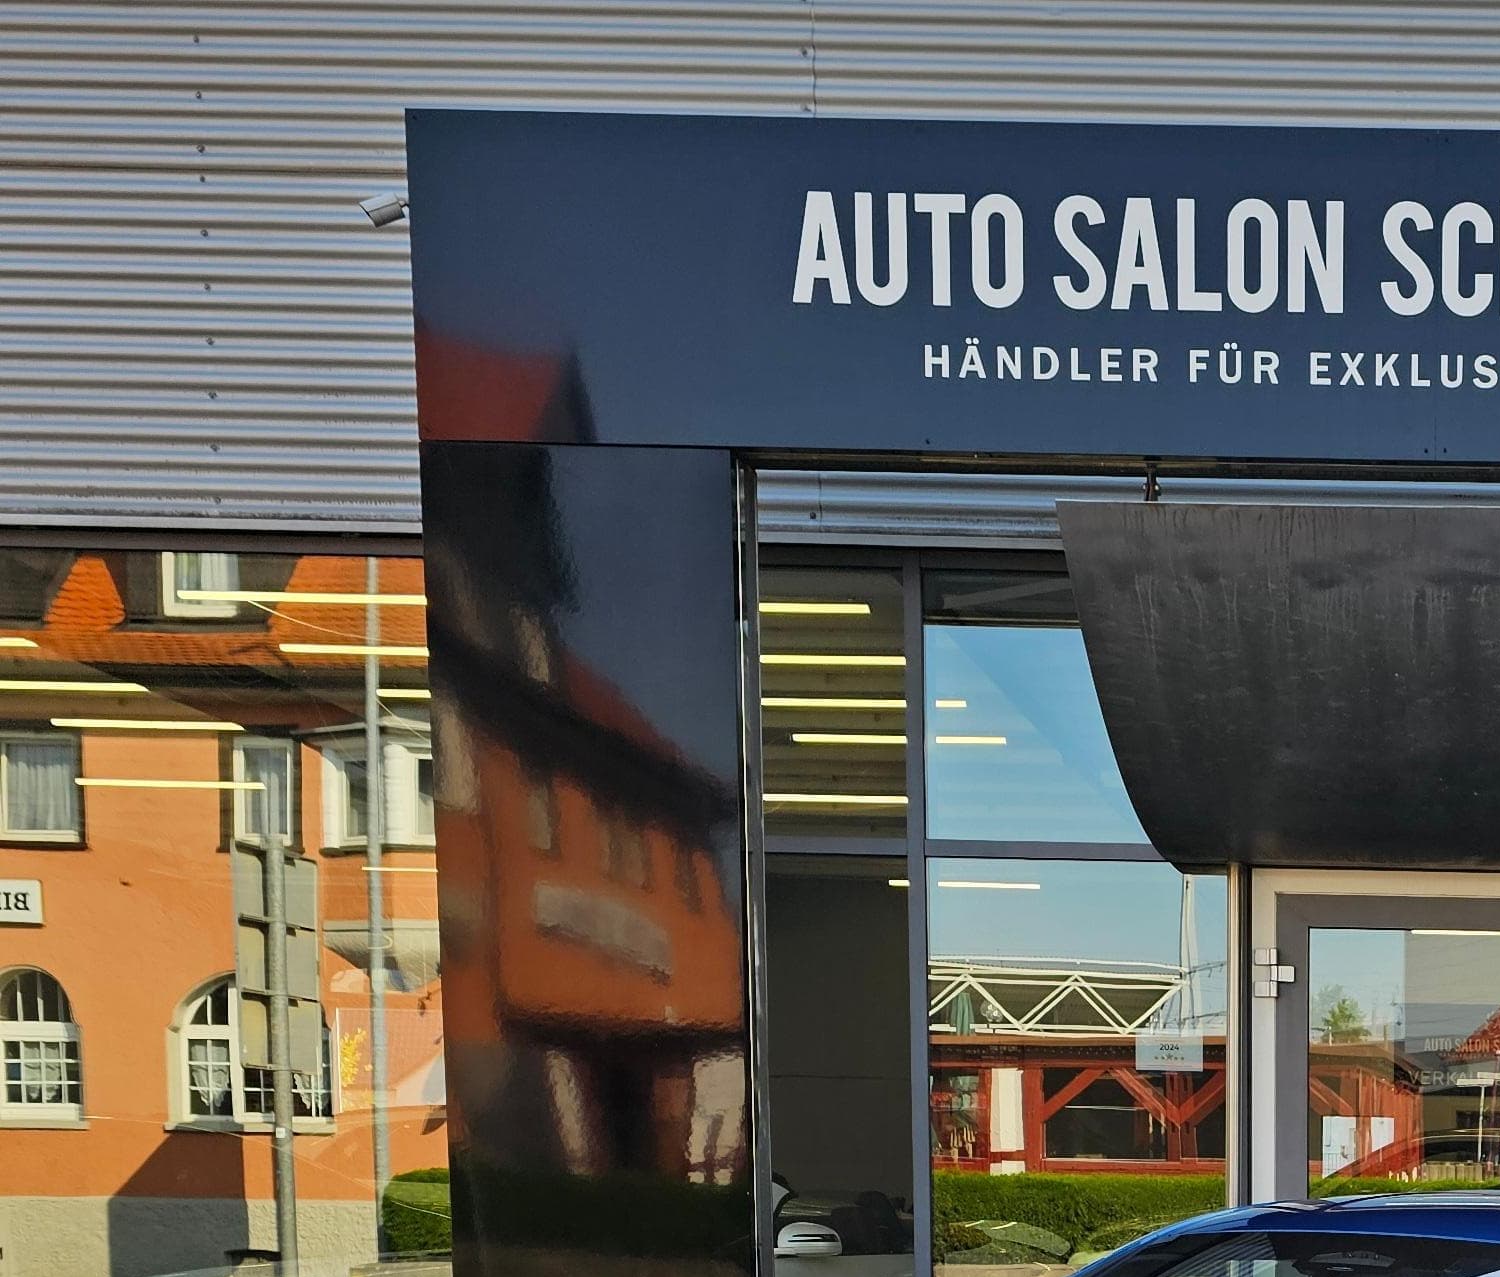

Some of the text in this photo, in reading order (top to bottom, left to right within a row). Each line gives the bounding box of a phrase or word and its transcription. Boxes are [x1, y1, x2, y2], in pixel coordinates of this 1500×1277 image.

[794, 191, 1024, 309] AUTO
[1053, 195, 1345, 314] SALON
[923, 338, 1159, 382] HÄNDLER
[1189, 342, 1280, 385] FÜR
[1160, 1043, 1179, 1051] 2024
